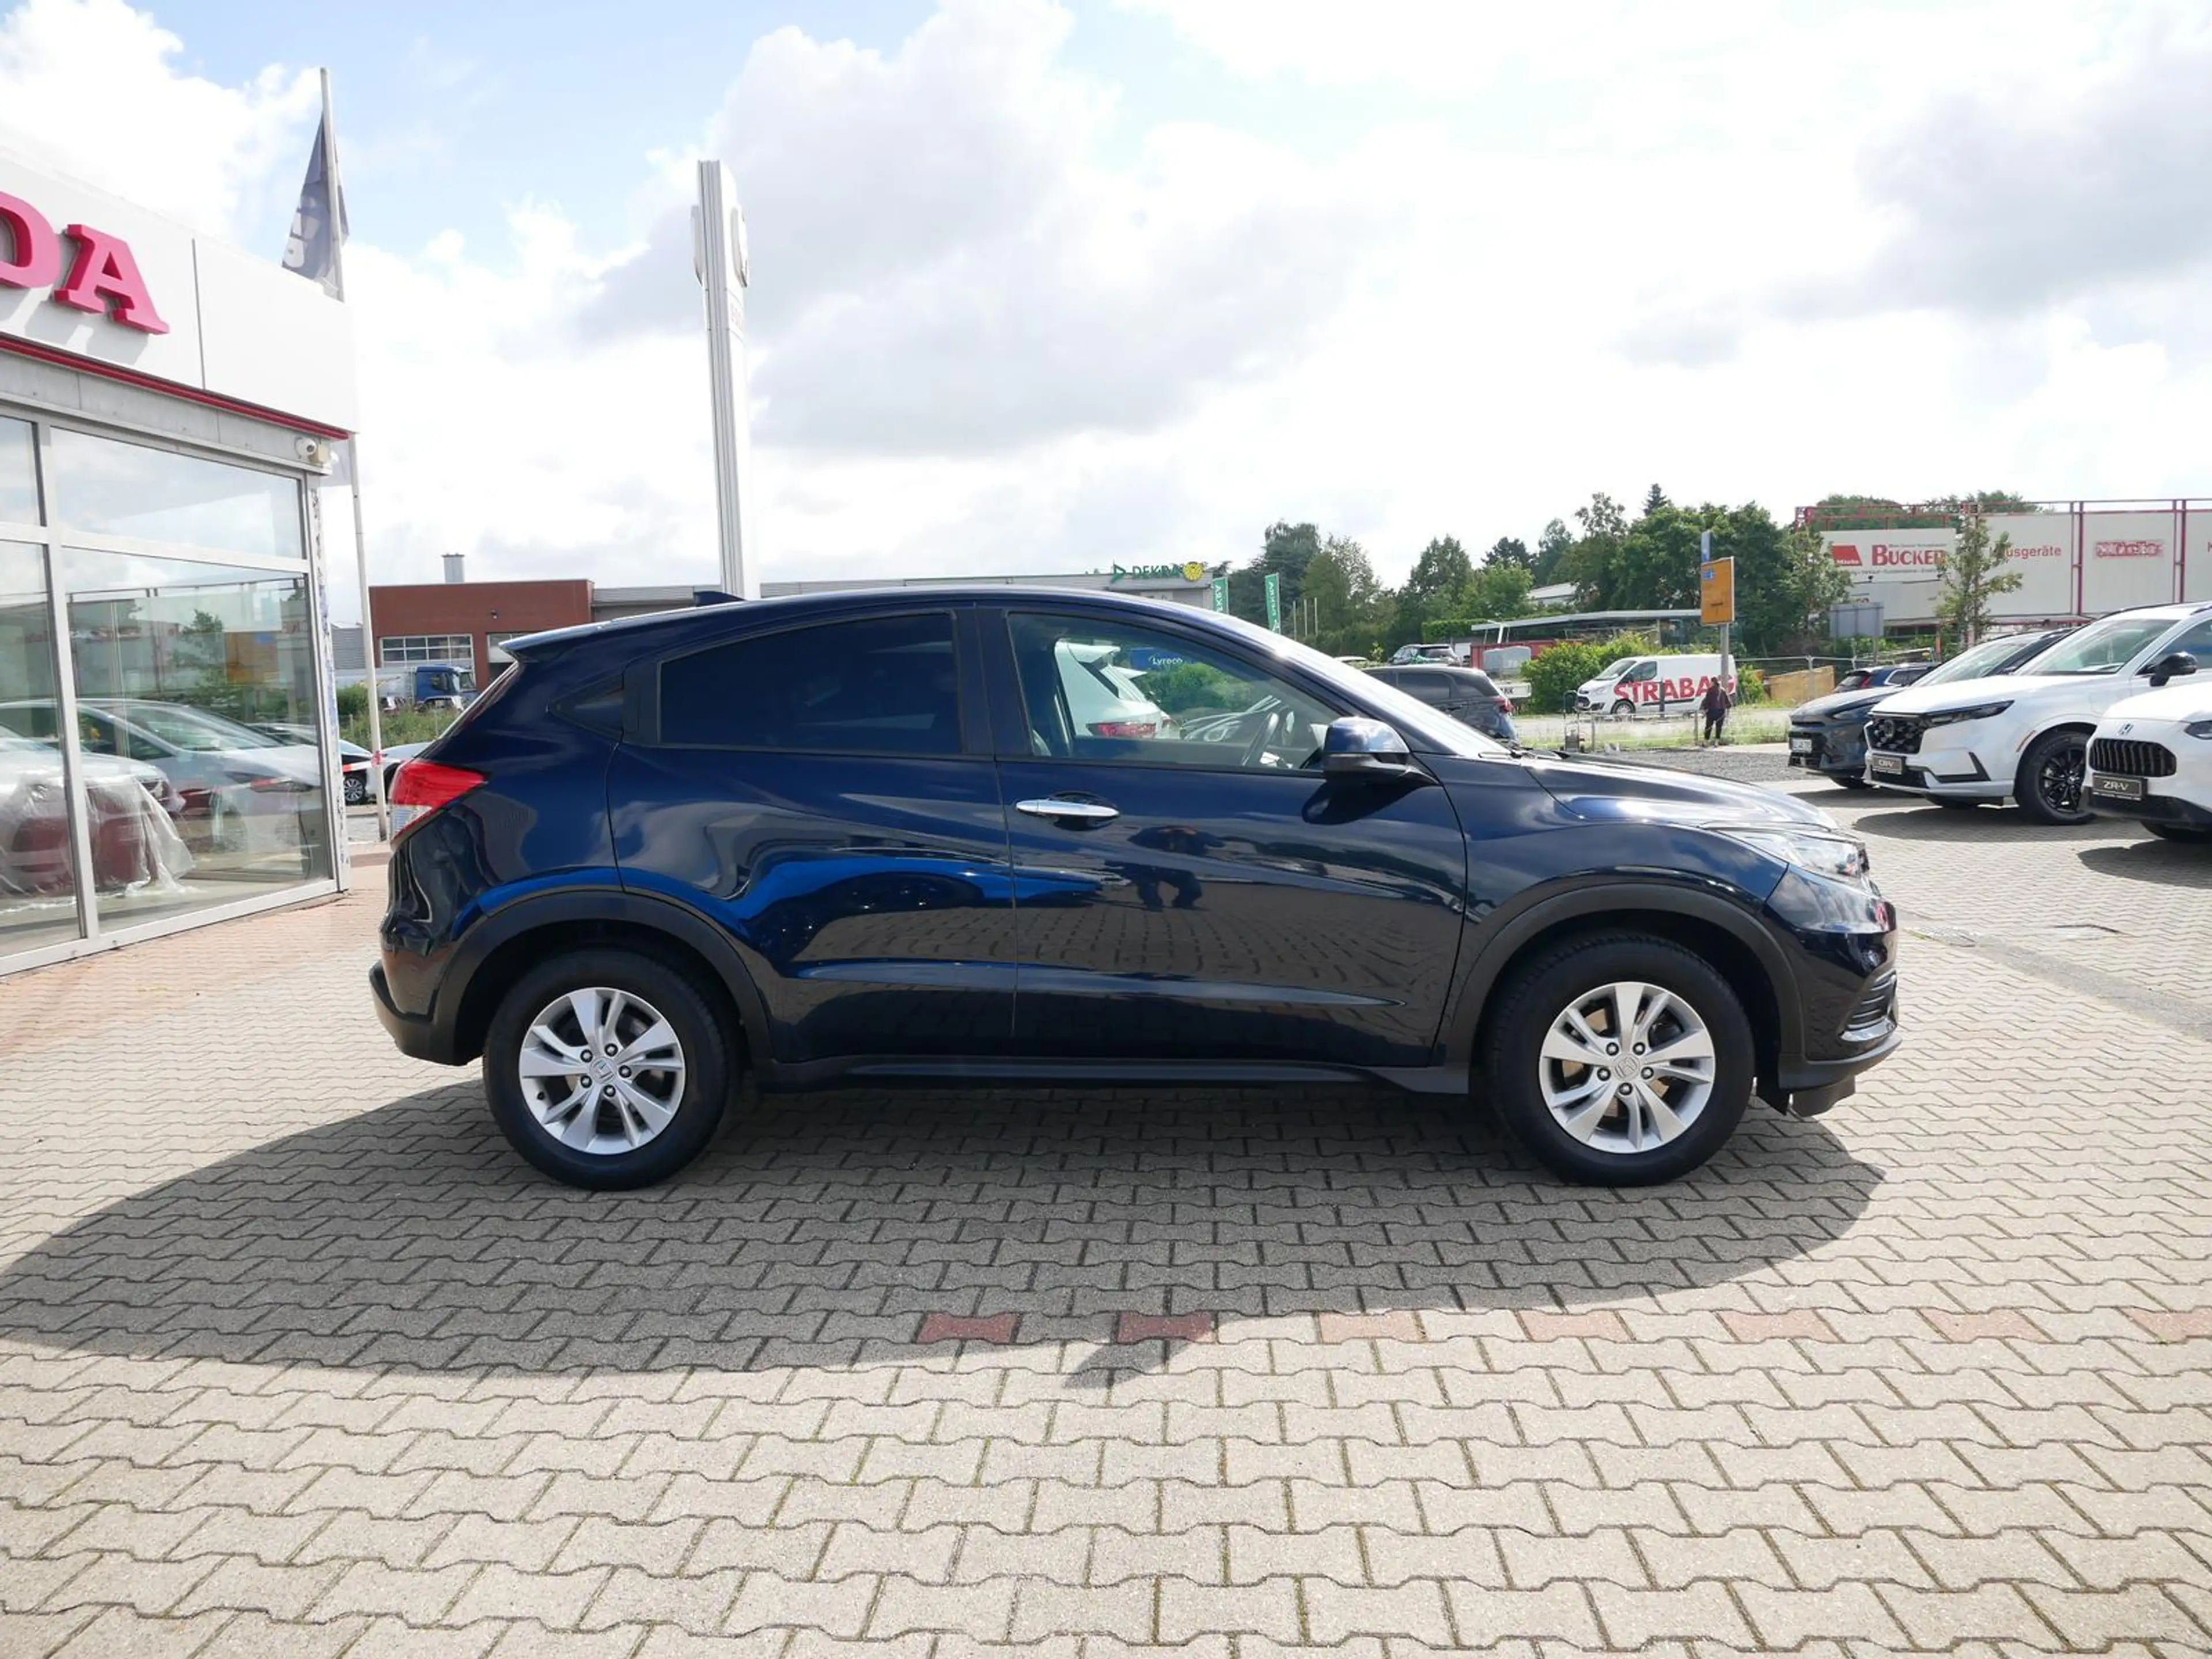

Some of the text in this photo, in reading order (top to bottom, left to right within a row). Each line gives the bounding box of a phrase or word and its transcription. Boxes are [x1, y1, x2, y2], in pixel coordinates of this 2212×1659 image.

[1990, 546, 2062, 559] usgeräte
[1132, 565, 1180, 578] DEKRA
[2103, 780, 2129, 790] ZR-V
